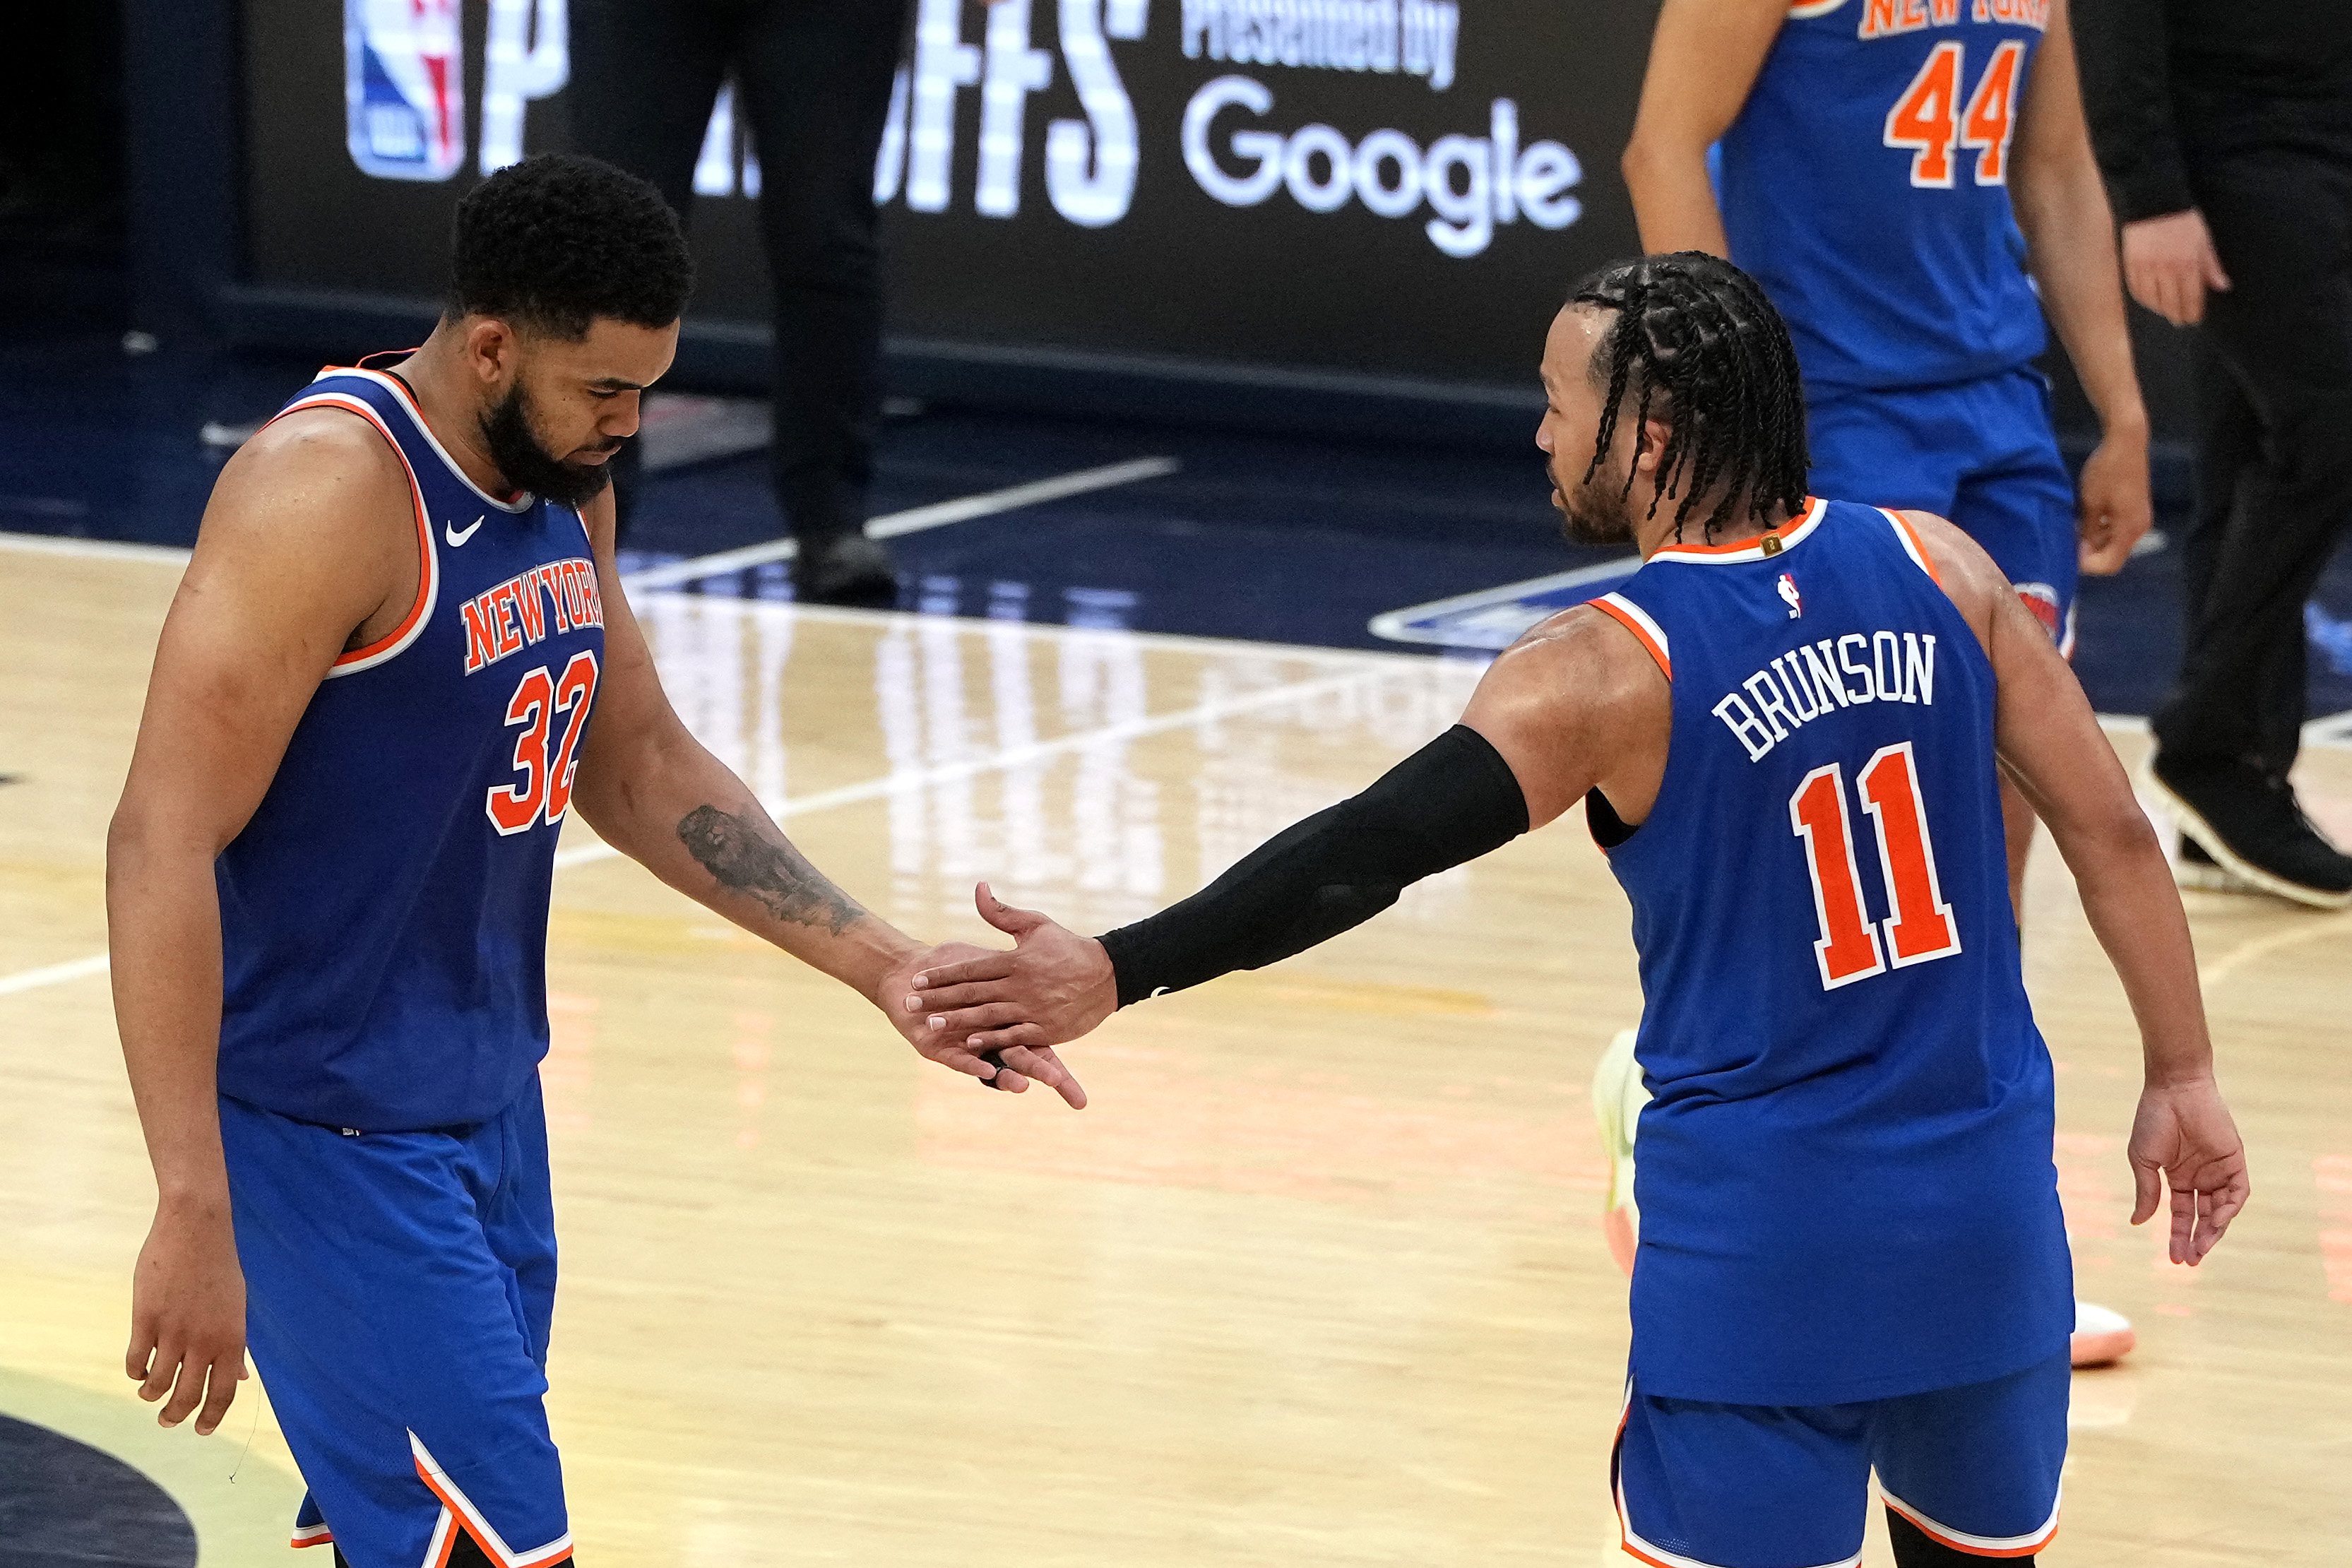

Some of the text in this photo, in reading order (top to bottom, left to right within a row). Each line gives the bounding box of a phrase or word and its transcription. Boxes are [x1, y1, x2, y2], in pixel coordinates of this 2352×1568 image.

[478, 0, 1149, 227] PFFS
[1402, 0, 1460, 91] by
[1883, 40, 2026, 189] 44
[1181, 74, 1583, 258] Google
[459, 557, 605, 677] NEW YORK
[1711, 630, 1936, 764] BRUNSON
[486, 649, 599, 836] 32
[1788, 741, 1962, 991] 11
